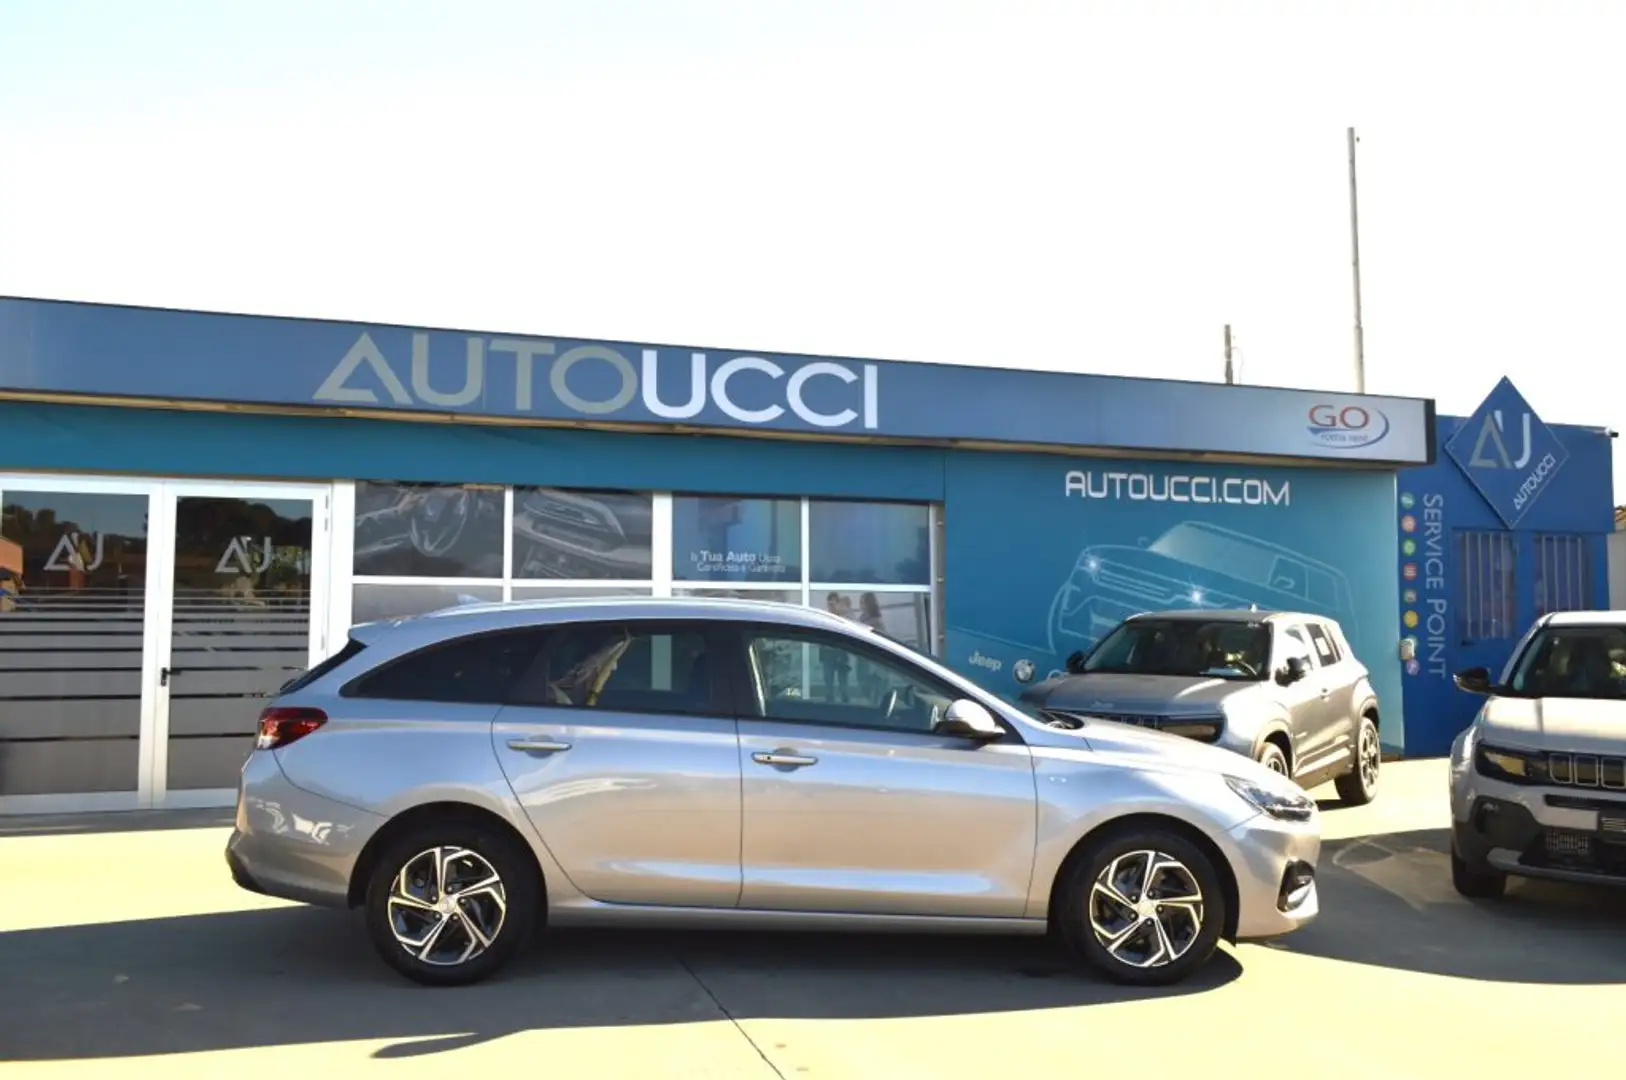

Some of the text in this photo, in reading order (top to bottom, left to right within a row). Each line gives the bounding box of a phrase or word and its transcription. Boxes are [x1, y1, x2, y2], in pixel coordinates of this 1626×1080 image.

[313, 332, 878, 429] AUTOUCCI
[1309, 405, 1369, 429] GO
[1065, 470, 1290, 506] AUTOUCCI.COM
[1513, 453, 1556, 510] AUTOUCCI
[700, 550, 723, 562] Tua
[726, 550, 756, 562] Auto
[1423, 493, 1447, 679] SERVICE POINT
[968, 650, 1002, 672] Jeep
